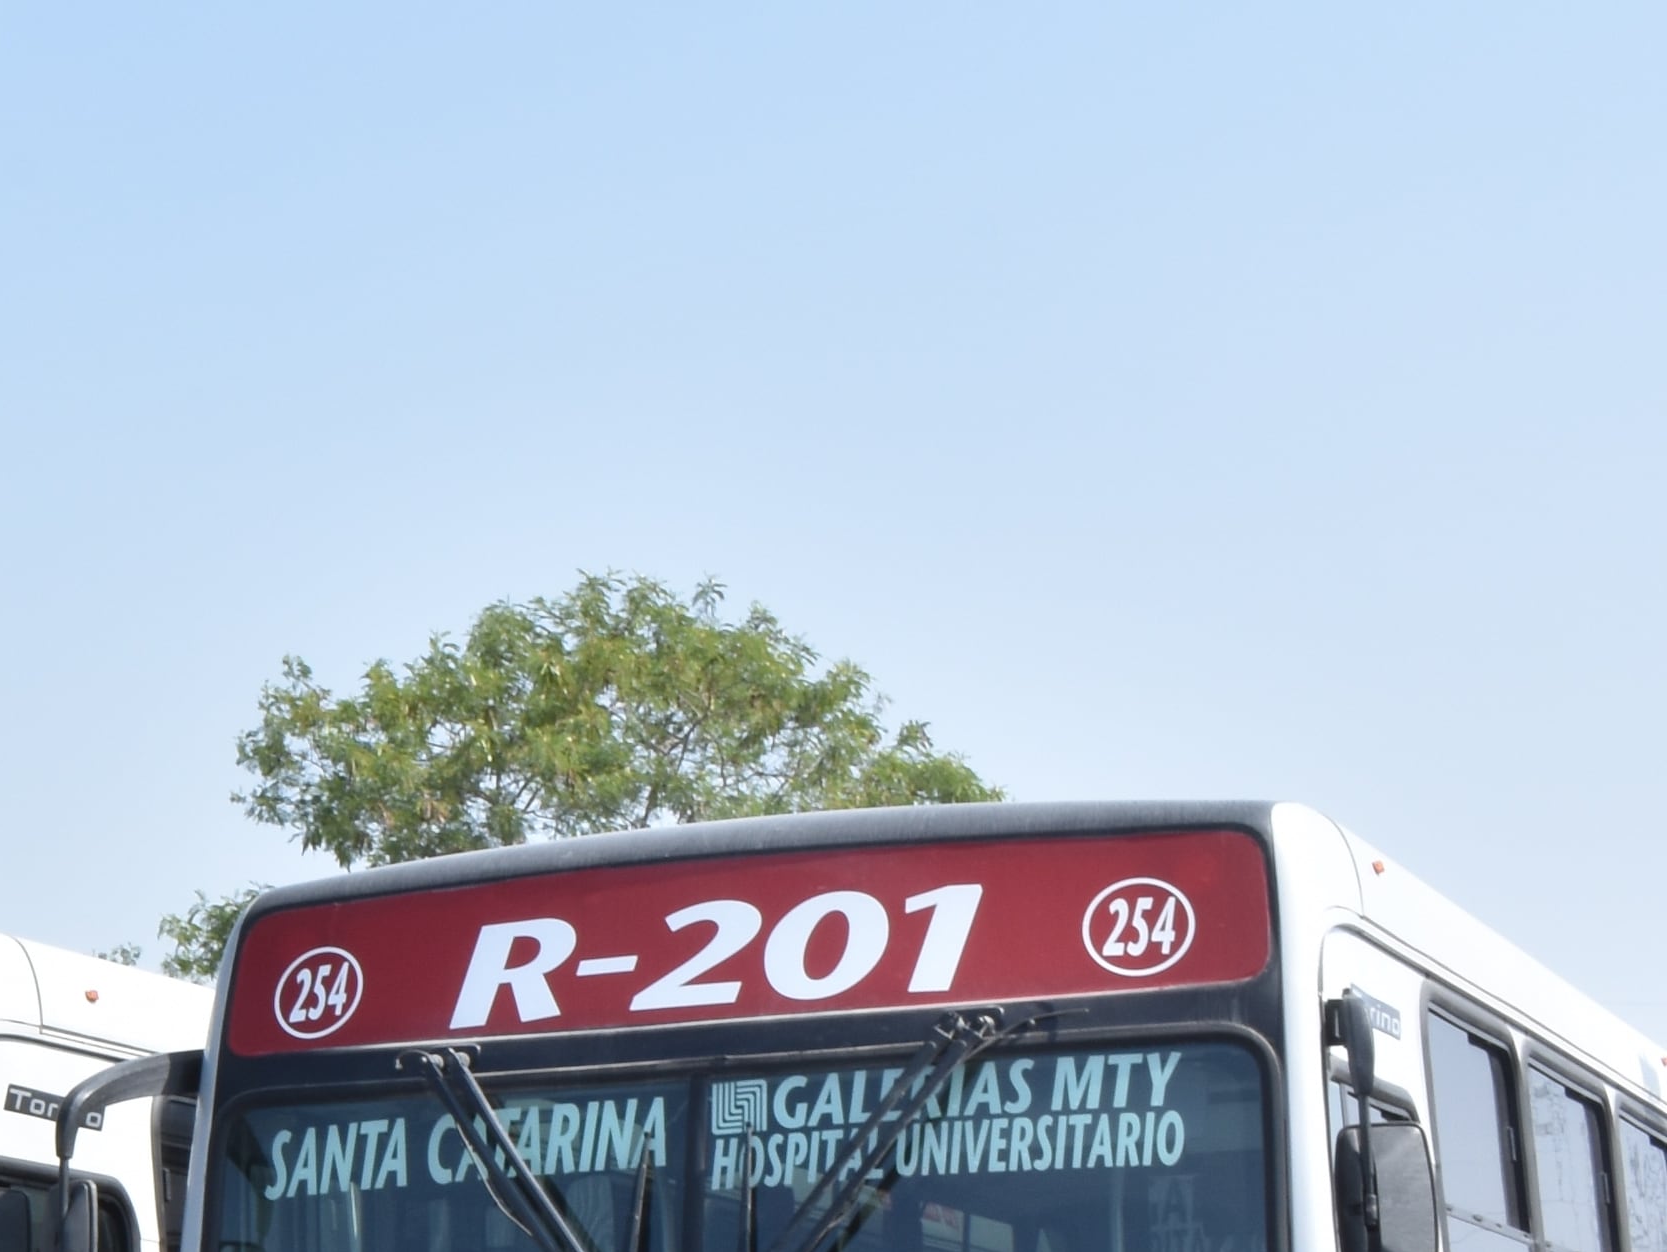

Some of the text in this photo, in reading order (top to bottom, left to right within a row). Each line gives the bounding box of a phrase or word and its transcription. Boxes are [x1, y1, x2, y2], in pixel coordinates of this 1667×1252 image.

[450, 883, 983, 1030] R-201
[1101, 896, 1176, 958] 254
[288, 962, 349, 1023] 254
[9, 1087, 103, 1128] Toro
[1051, 1051, 1182, 1112] MTY
[265, 1117, 408, 1200] SANTA
[896, 1110, 1186, 1177] UNIVERSITARIO
